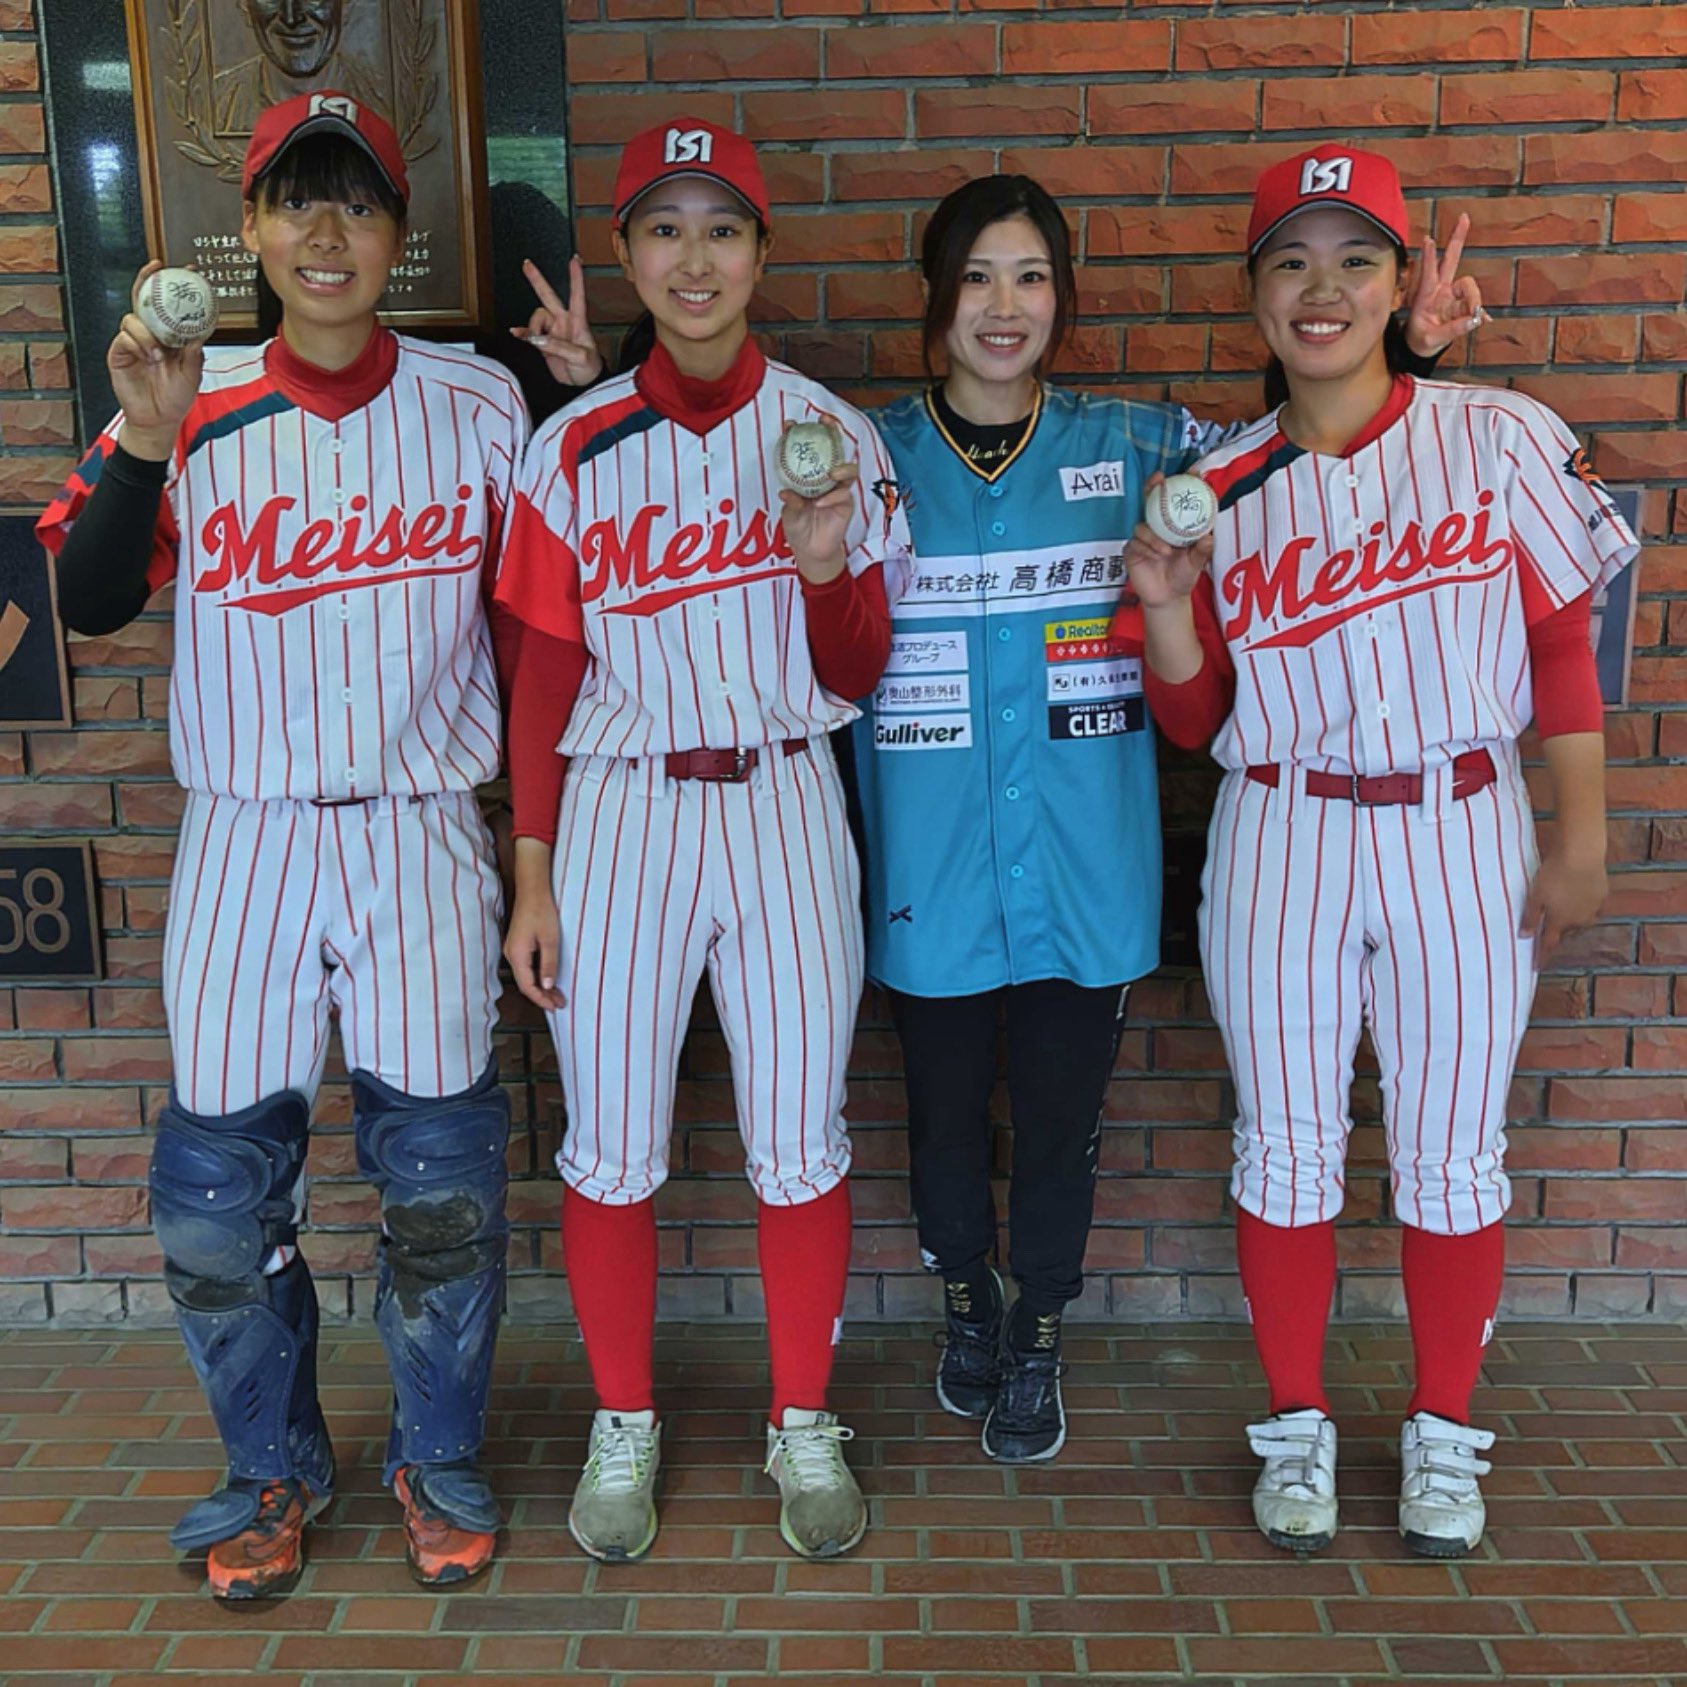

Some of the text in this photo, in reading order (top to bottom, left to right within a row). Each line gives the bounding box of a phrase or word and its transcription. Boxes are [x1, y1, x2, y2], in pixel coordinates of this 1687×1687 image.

[1071, 468, 1120, 495] Arai
[194, 484, 482, 593] Meisei
[1222, 489, 1514, 643] Meisei
[916, 571, 1000, 594] 株式会社
[902, 652, 940, 664] グループ
[875, 722, 965, 745] Gulliver
[1069, 711, 1127, 737] CLEAR
